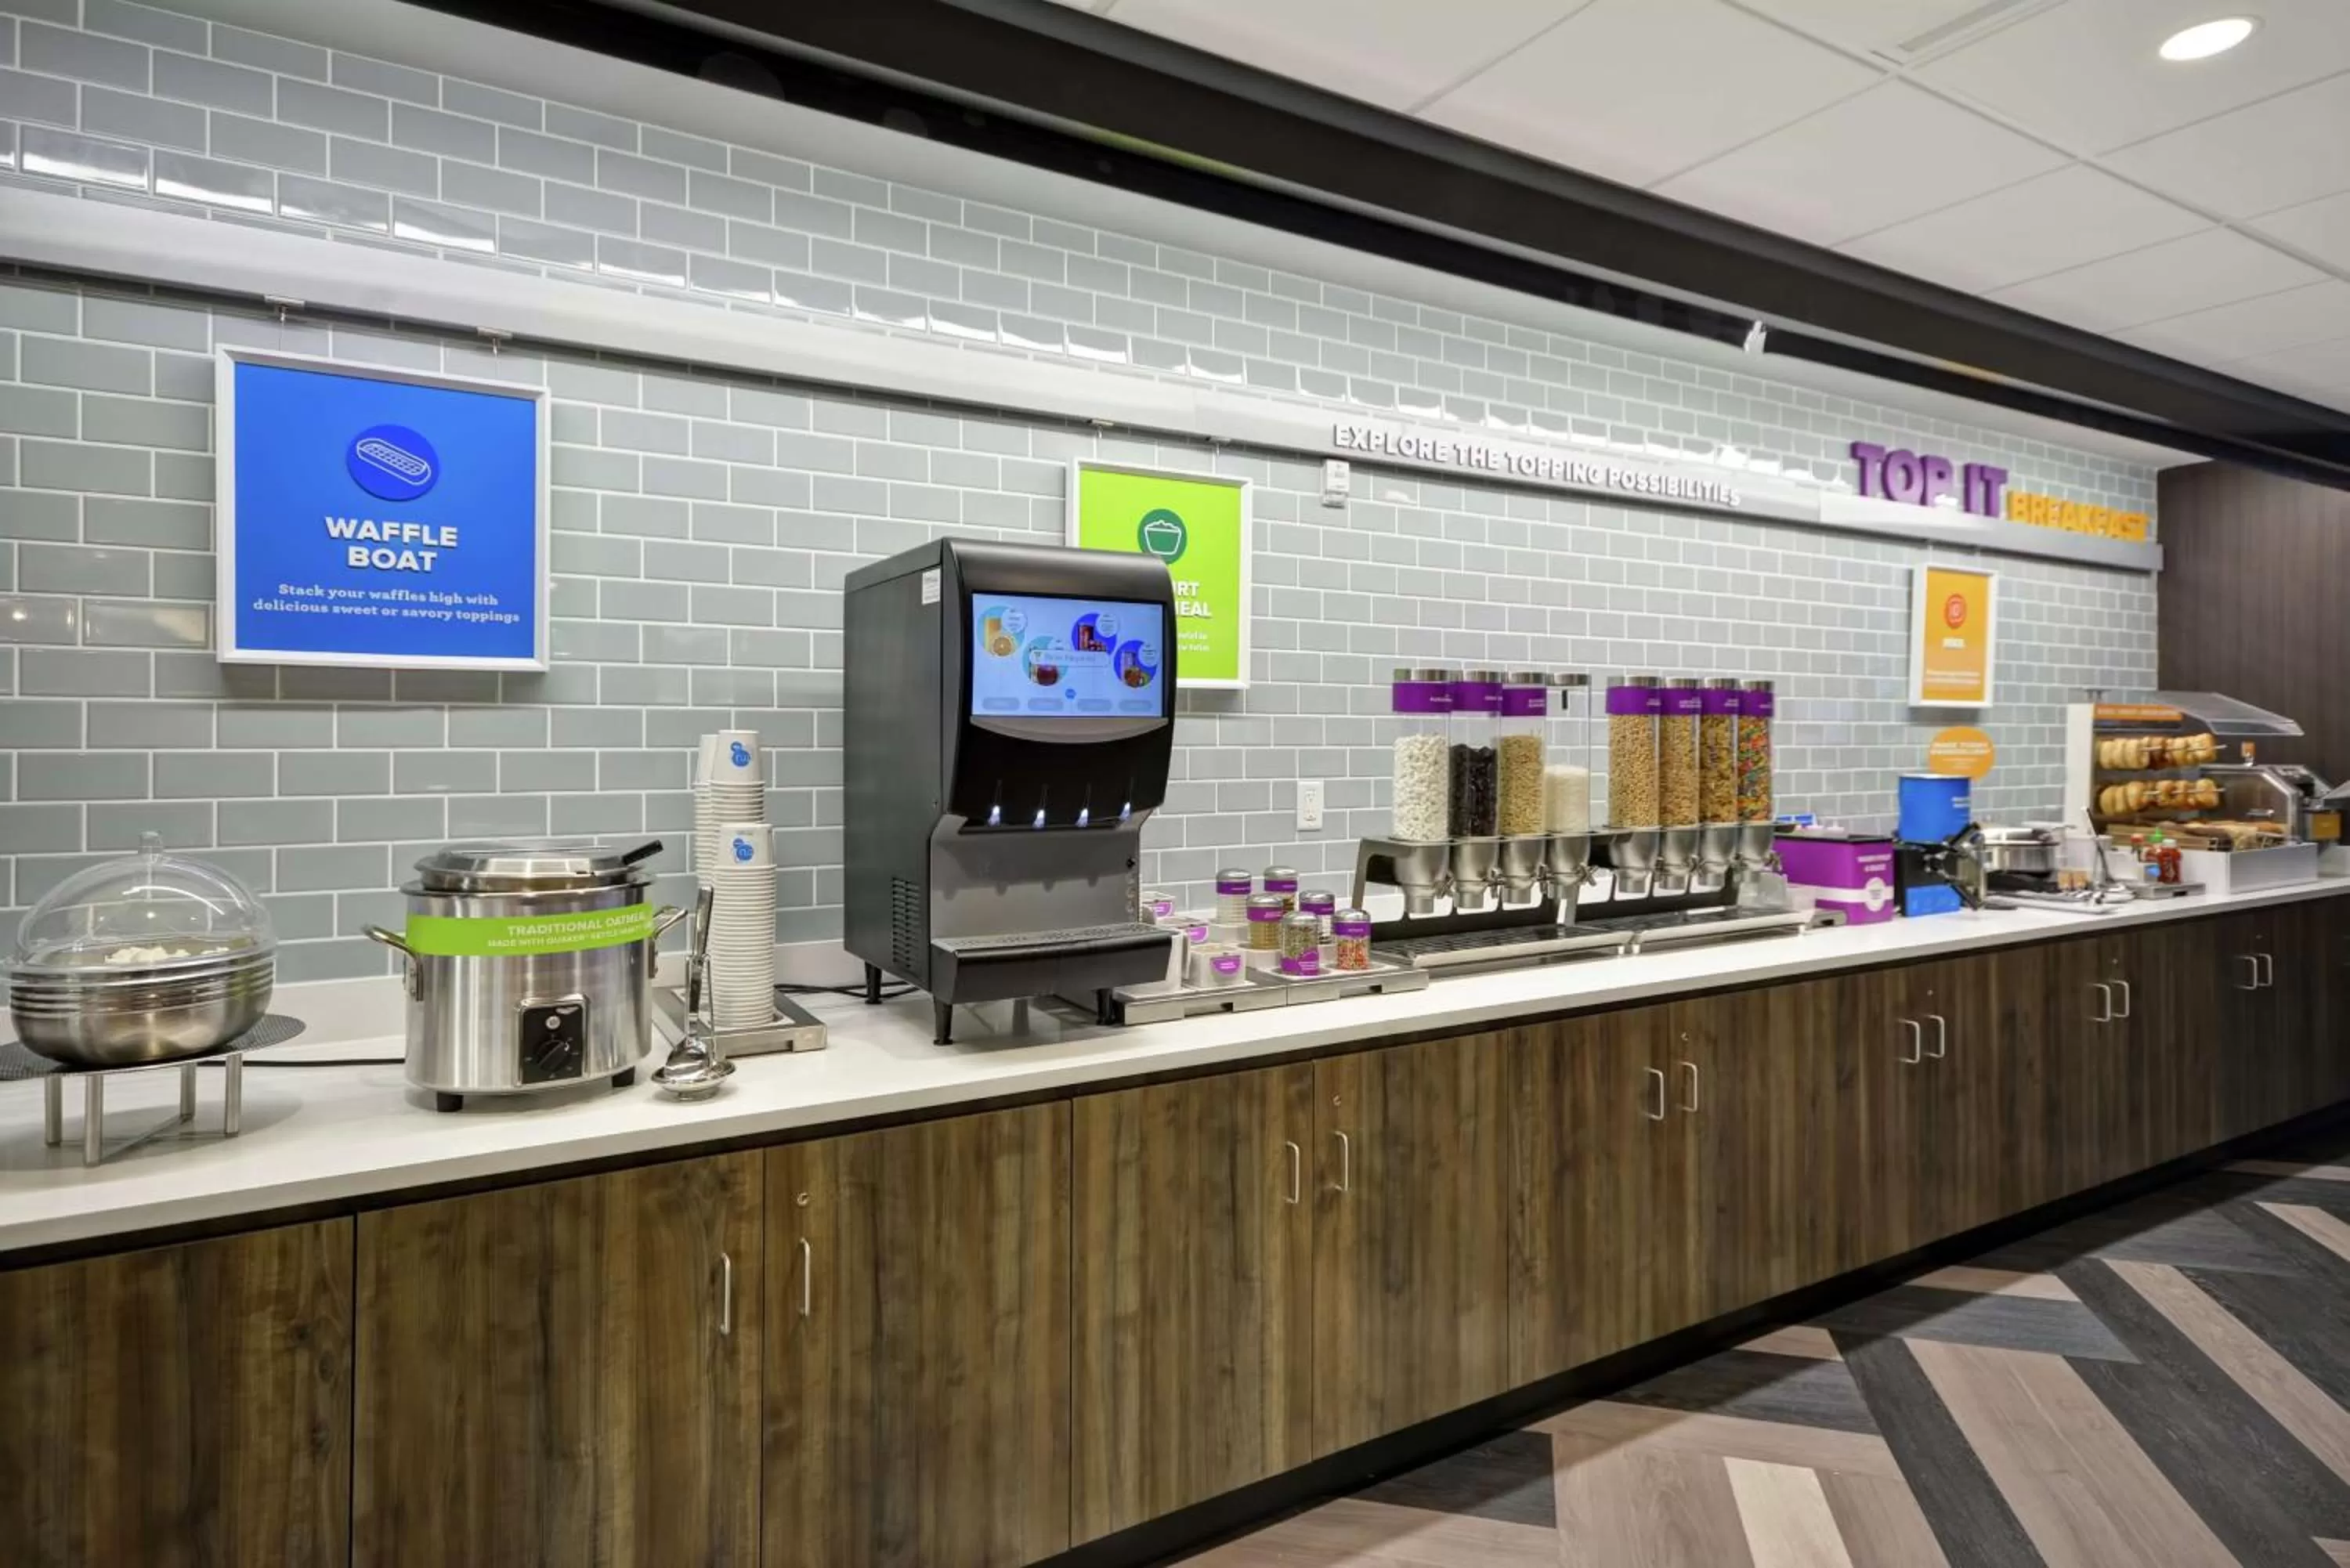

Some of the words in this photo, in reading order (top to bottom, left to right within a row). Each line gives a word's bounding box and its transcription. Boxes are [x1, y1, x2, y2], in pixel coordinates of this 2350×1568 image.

[1333, 424, 1448, 463] EXPLORE
[1453, 443, 1499, 470] THE
[1504, 452, 1601, 484] TOPPING
[1606, 467, 1741, 507] POSSIBILITIES
[1850, 441, 1954, 506] TOP
[1963, 463, 2008, 518] IT
[325, 516, 458, 547] WAFFLE
[348, 546, 438, 572] BOAT
[278, 583, 324, 597] Stack
[327, 588, 366, 601] your
[369, 589, 427, 602] waffles
[428, 591, 463, 606] high
[465, 594, 499, 605] with
[253, 598, 329, 613] delicious
[332, 603, 378, 616] sweet
[381, 606, 399, 616] or
[402, 608, 453, 621] savory
[456, 609, 520, 623] toppings
[508, 919, 602, 938] TRADITIONAL
